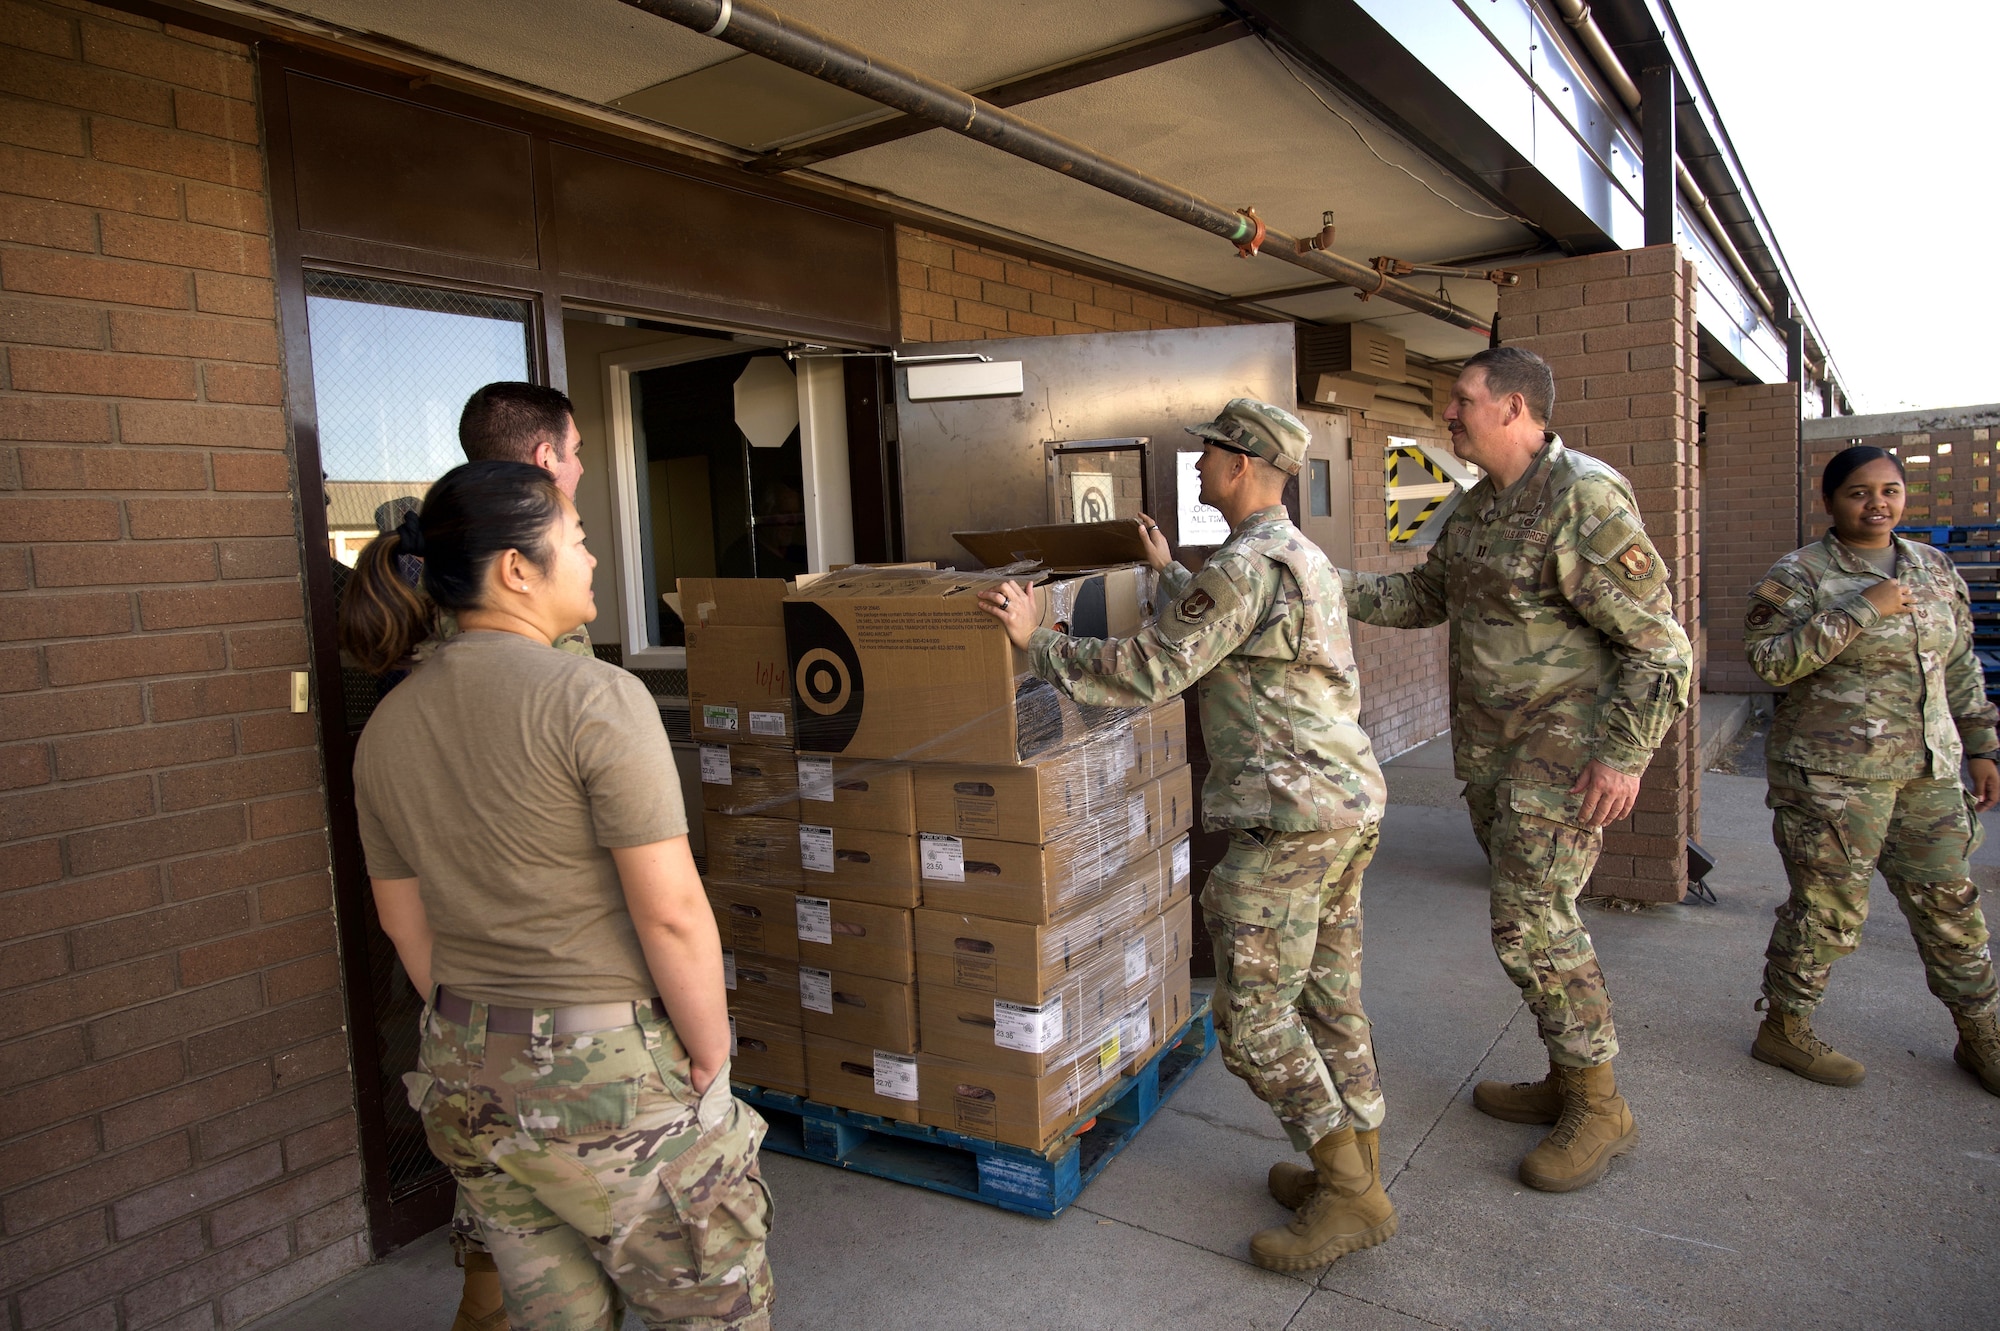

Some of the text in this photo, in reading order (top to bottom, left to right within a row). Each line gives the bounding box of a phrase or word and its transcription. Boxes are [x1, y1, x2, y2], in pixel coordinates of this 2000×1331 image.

[1190, 515, 1227, 523] ALL TIM
[730, 718, 737, 730] 2
[926, 862, 943, 871] 23.50
[996, 1029, 1015, 1040] 23.35
[875, 1078, 892, 1088] 22.70
